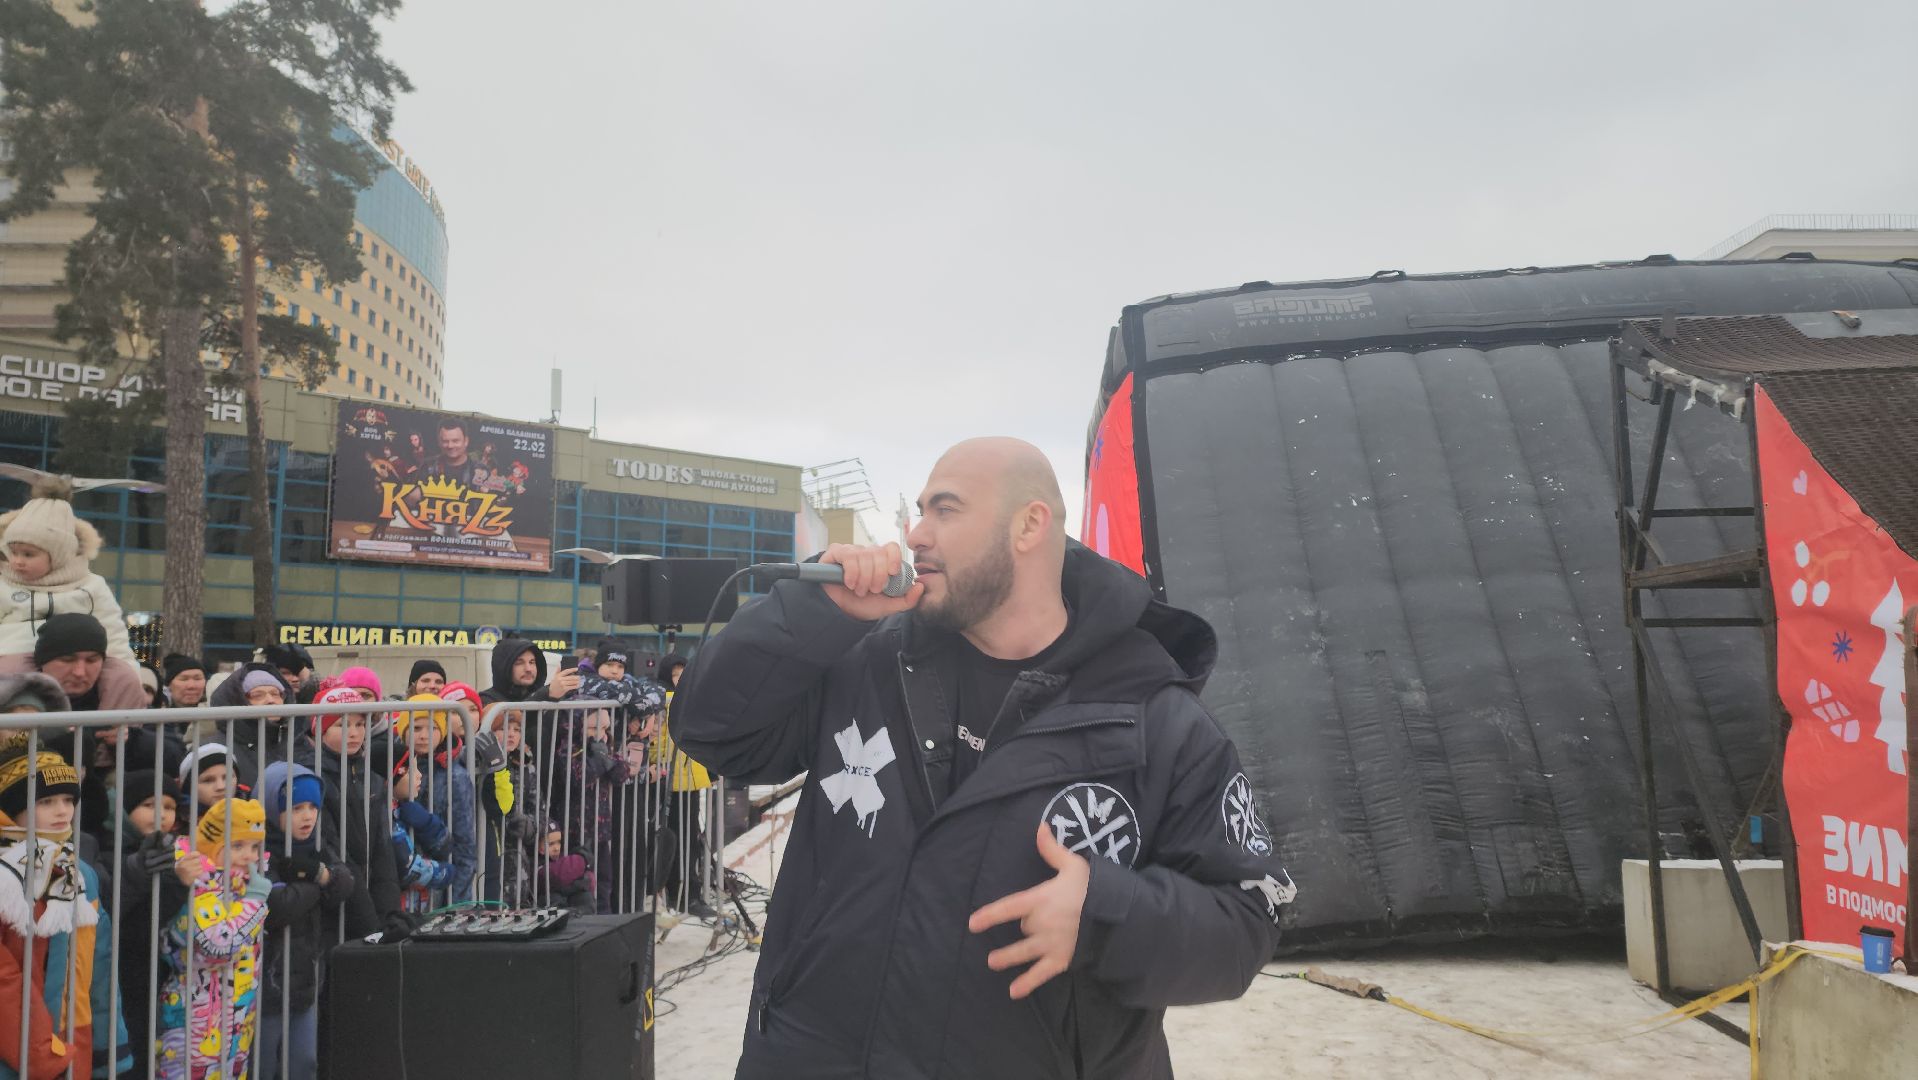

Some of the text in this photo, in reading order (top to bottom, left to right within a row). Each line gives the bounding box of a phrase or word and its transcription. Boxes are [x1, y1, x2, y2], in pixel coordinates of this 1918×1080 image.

[0, 355, 106, 384] СШОР
[513, 438, 546, 453] 22.02
[613, 458, 694, 485] TODES
[701, 469, 775, 484] ШКОЛА СТУДИЯ
[701, 479, 729, 489] АЛЛЫ
[280, 625, 469, 646] СЕКЦИЯ БОКСА
[532, 639, 567, 650] ЕЕВА
[1826, 883, 1837, 905] В
